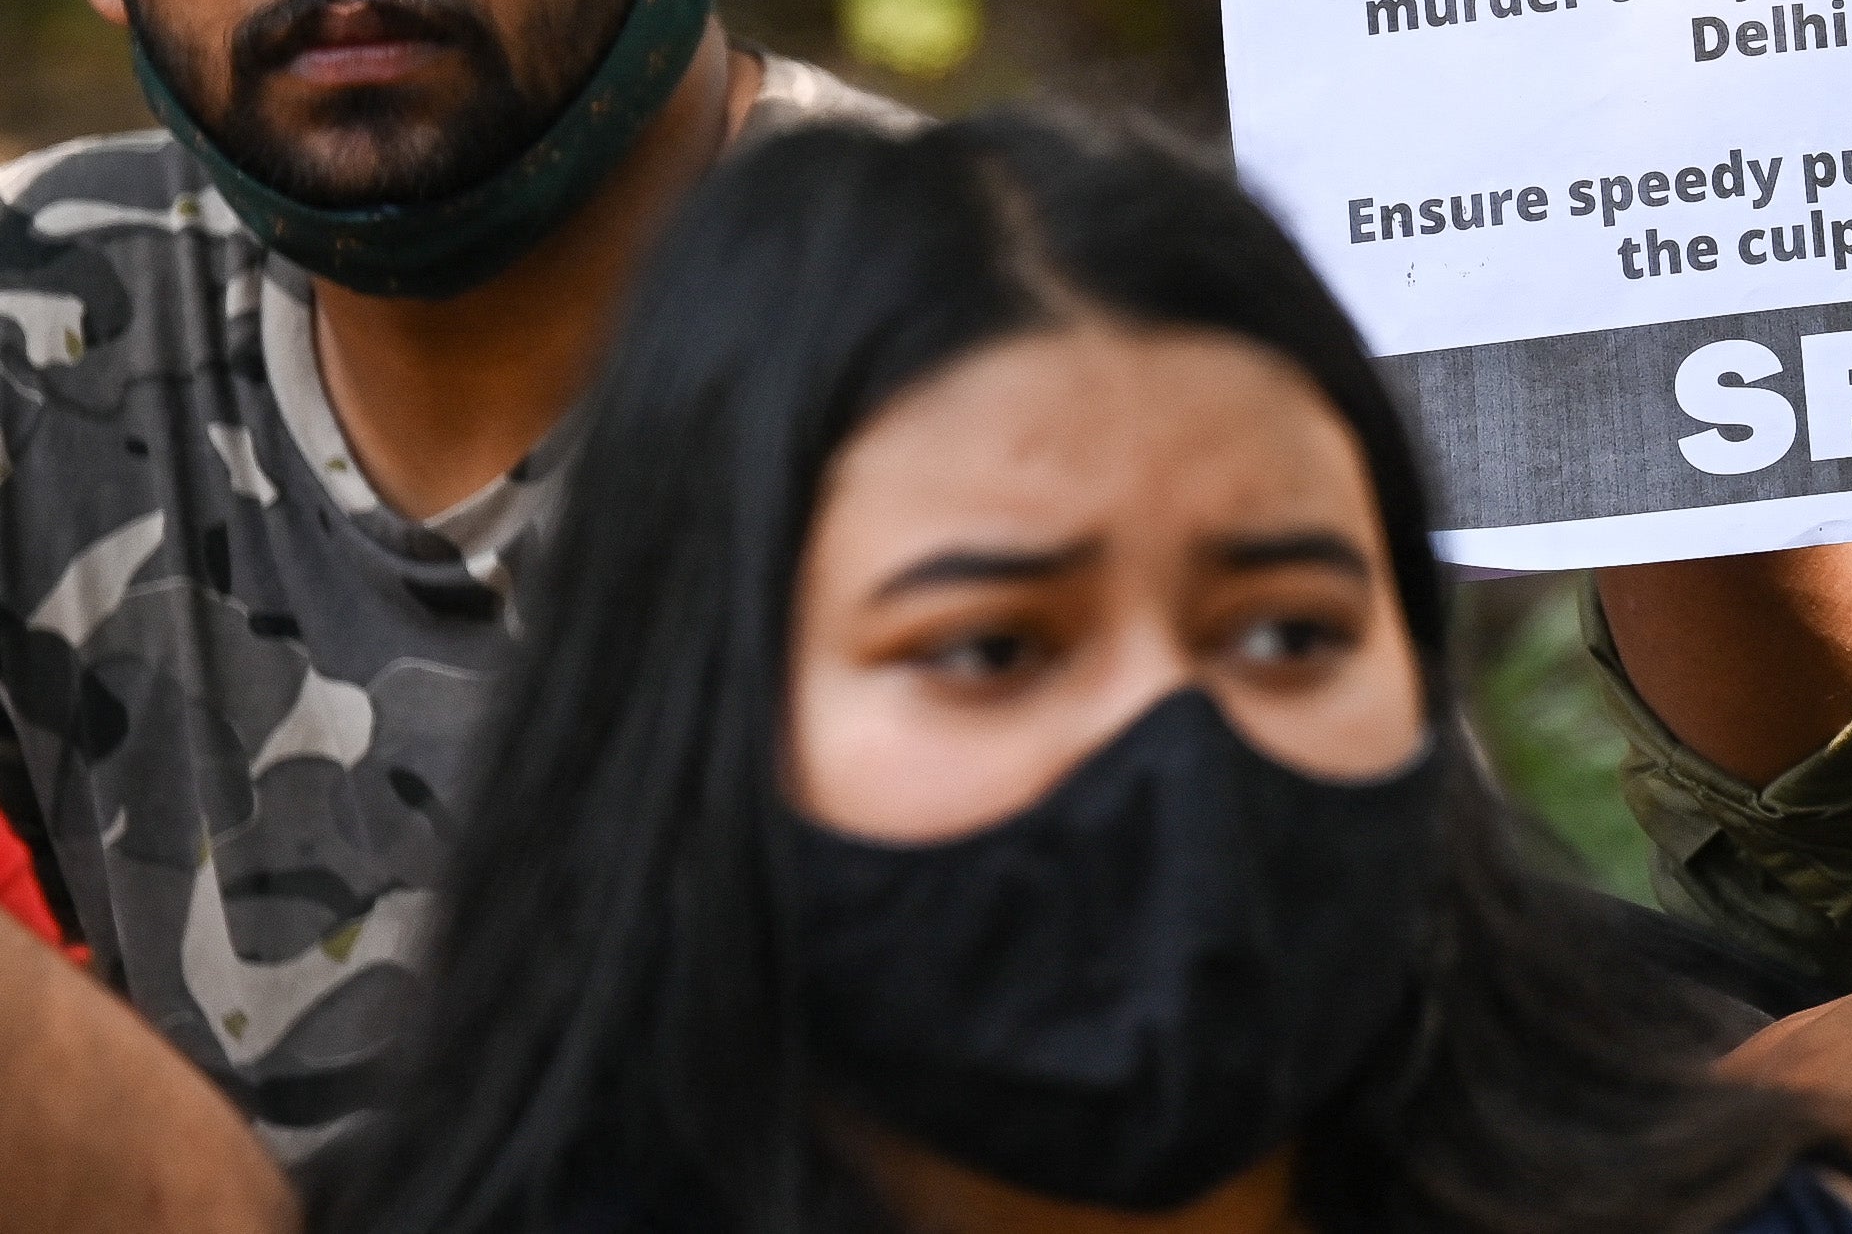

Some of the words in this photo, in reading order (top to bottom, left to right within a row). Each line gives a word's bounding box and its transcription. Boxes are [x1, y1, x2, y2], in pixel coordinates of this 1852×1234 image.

[1349, 187, 1548, 244] Ensure
[1569, 149, 1782, 227] speedy
[1618, 229, 1718, 279] the
